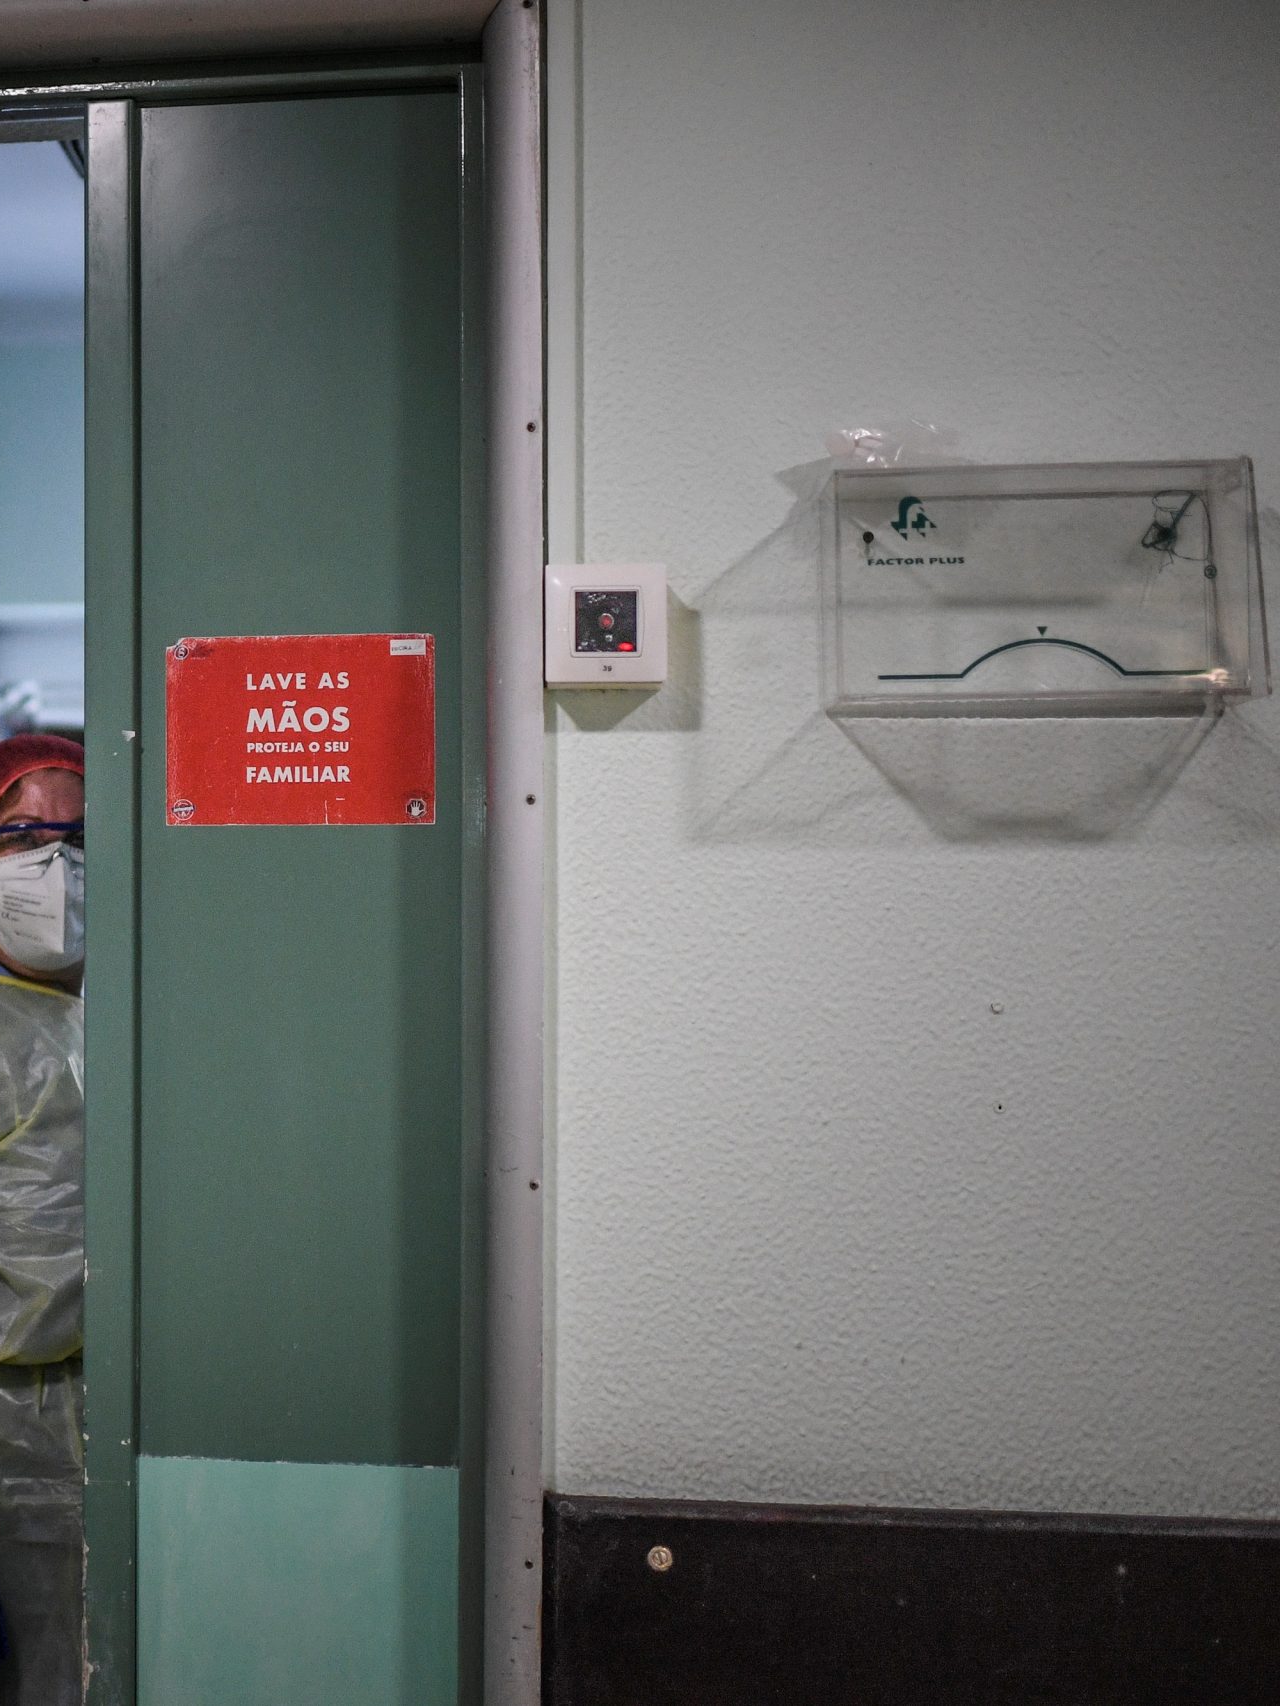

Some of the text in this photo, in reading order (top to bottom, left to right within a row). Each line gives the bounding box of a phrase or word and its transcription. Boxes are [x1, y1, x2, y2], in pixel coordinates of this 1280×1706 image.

[867, 556, 965, 566] FACTOR PLUS
[246, 671, 350, 691] LAVE AS
[246, 700, 351, 733] MÃOS
[246, 741, 350, 754] PROTEJA O SEU
[246, 765, 351, 783] FAMILIAR
